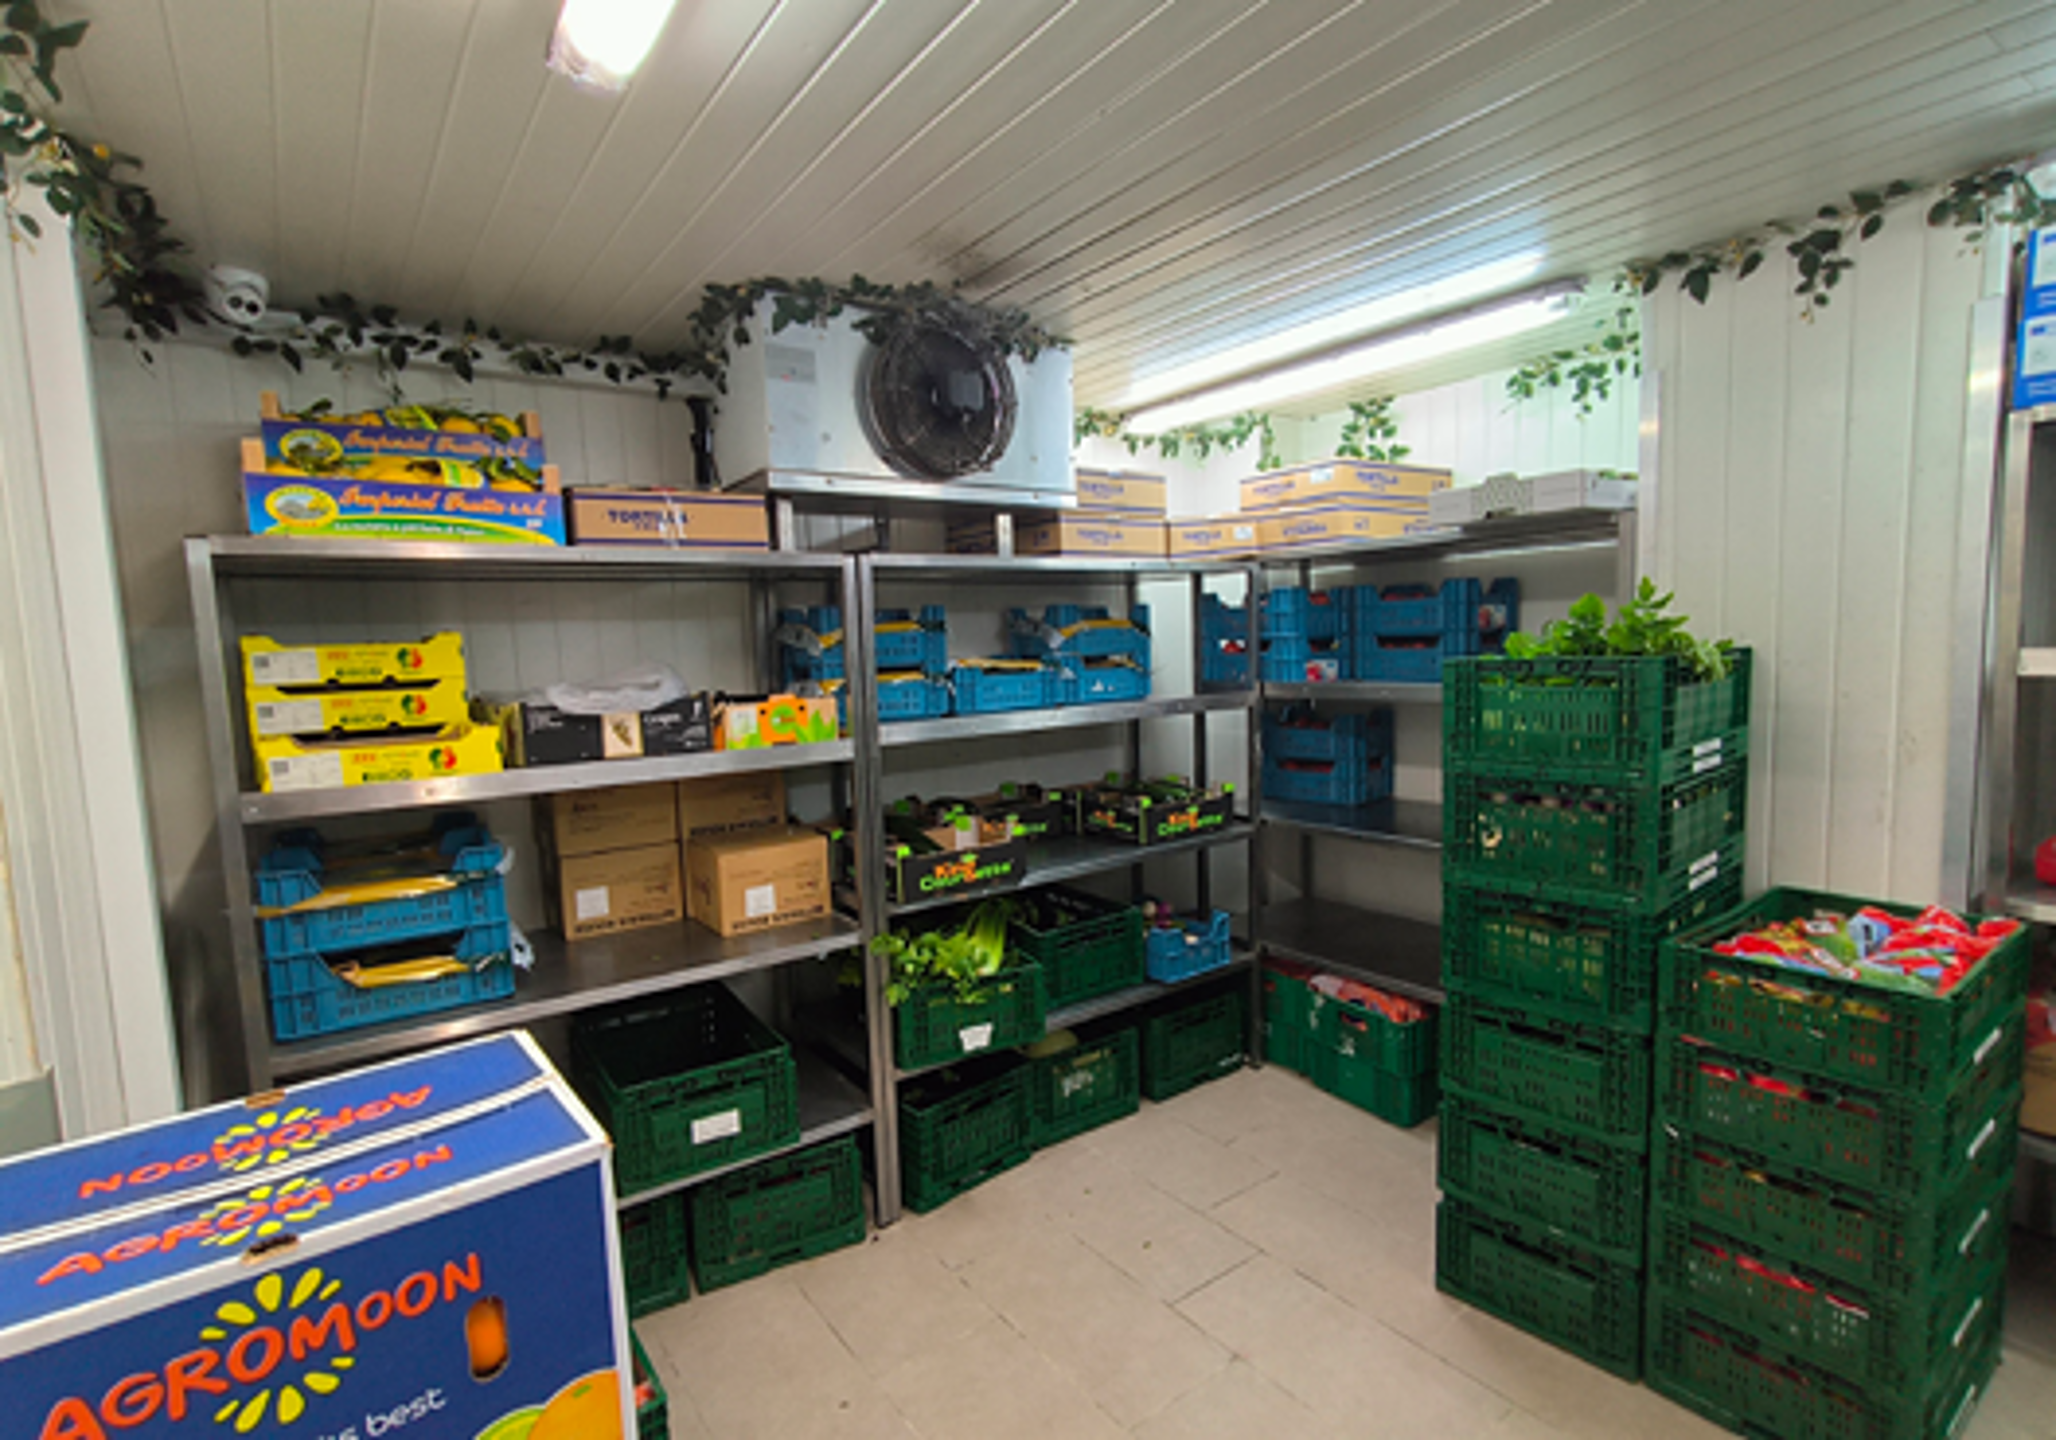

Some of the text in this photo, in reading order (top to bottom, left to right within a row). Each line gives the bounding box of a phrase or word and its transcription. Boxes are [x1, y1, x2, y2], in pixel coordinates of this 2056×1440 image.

[78, 1085, 434, 1199] AGROMOON
[35, 1145, 454, 1286] AGROMOON
[37, 1252, 483, 1440] AGROMOON
[364, 1386, 448, 1438] best
